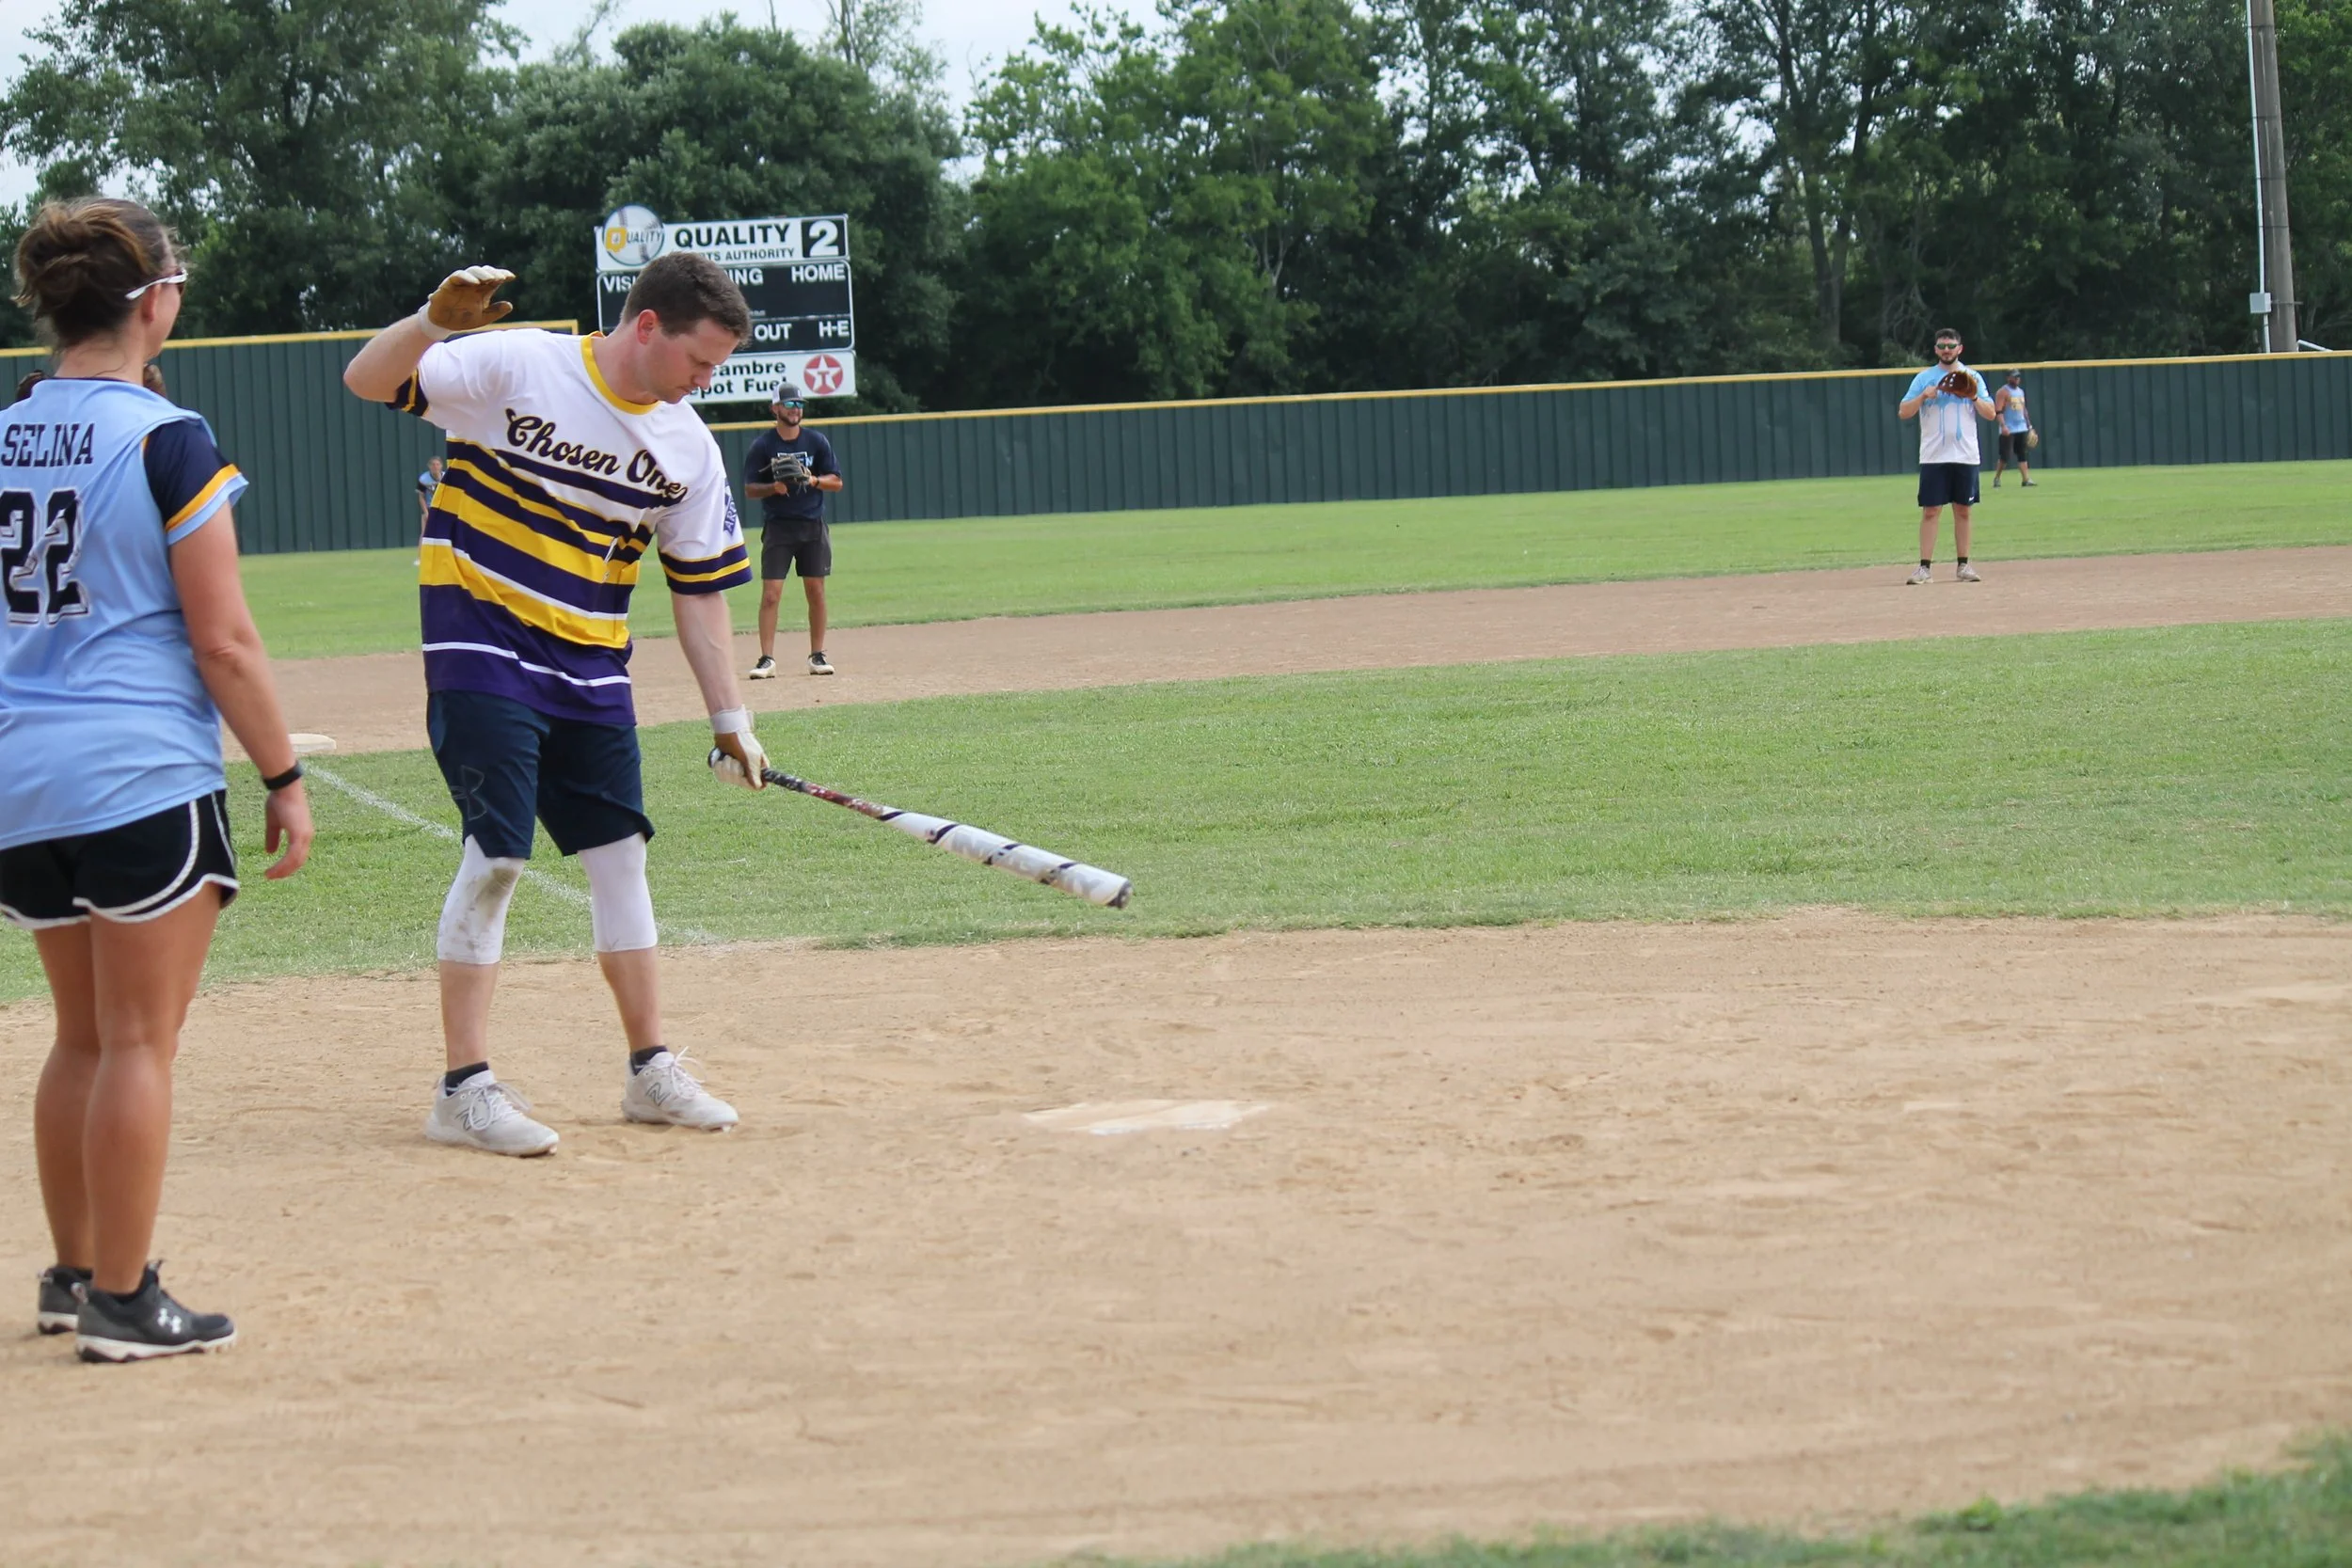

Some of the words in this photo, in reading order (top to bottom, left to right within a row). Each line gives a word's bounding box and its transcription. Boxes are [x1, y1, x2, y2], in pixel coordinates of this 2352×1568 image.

[675, 223, 790, 247] QUALITY
[809, 219, 839, 257] 2
[725, 247, 795, 261] AUTHORITY
[791, 264, 846, 282] HOME
[754, 323, 792, 341] OUT
[818, 320, 850, 338] H-E
[1, 423, 94, 467] SELINA
[505, 407, 621, 474] Chosen
[0, 486, 90, 625] 22
